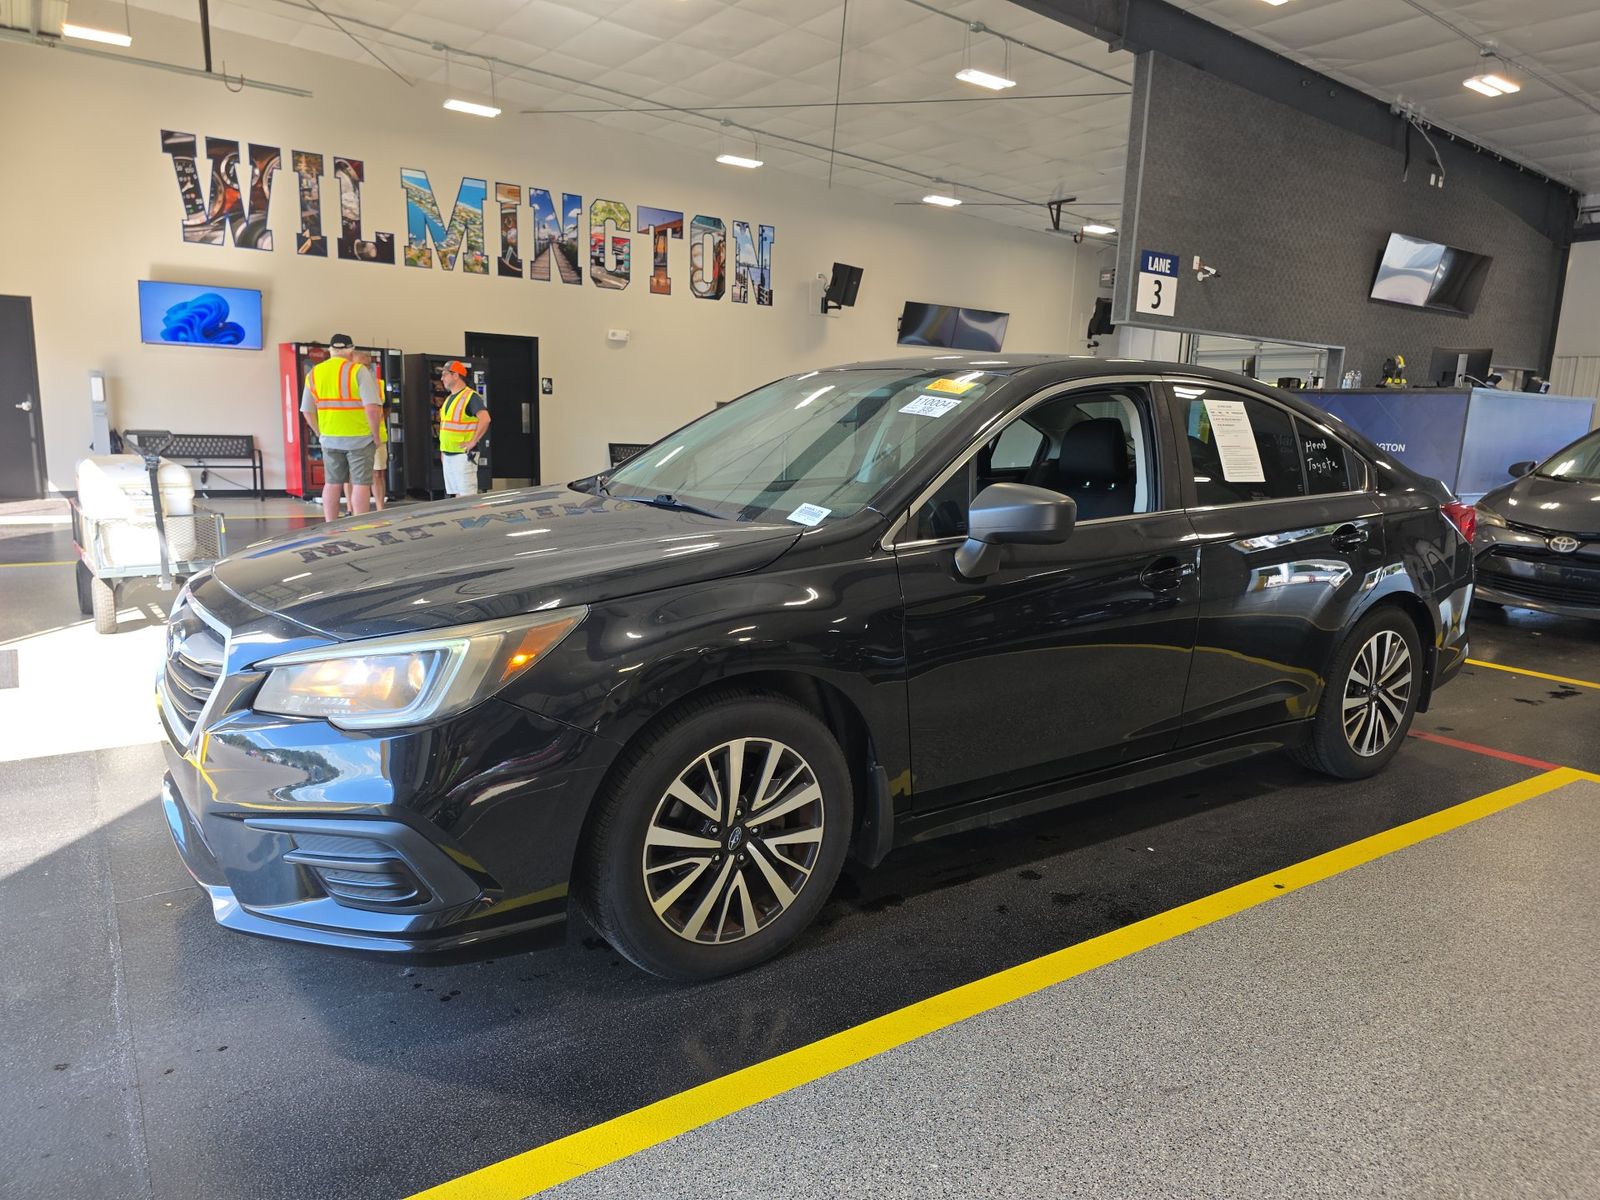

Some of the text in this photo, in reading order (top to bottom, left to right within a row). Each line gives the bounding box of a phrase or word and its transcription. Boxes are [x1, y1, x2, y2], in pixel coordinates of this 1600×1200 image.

[160, 129, 775, 306] WILMINGTON
[1148, 256, 1171, 273] LANE
[1151, 280, 1162, 309] 3
[1376, 443, 1406, 452] GTON
[1306, 457, 1338, 474] Toyota
